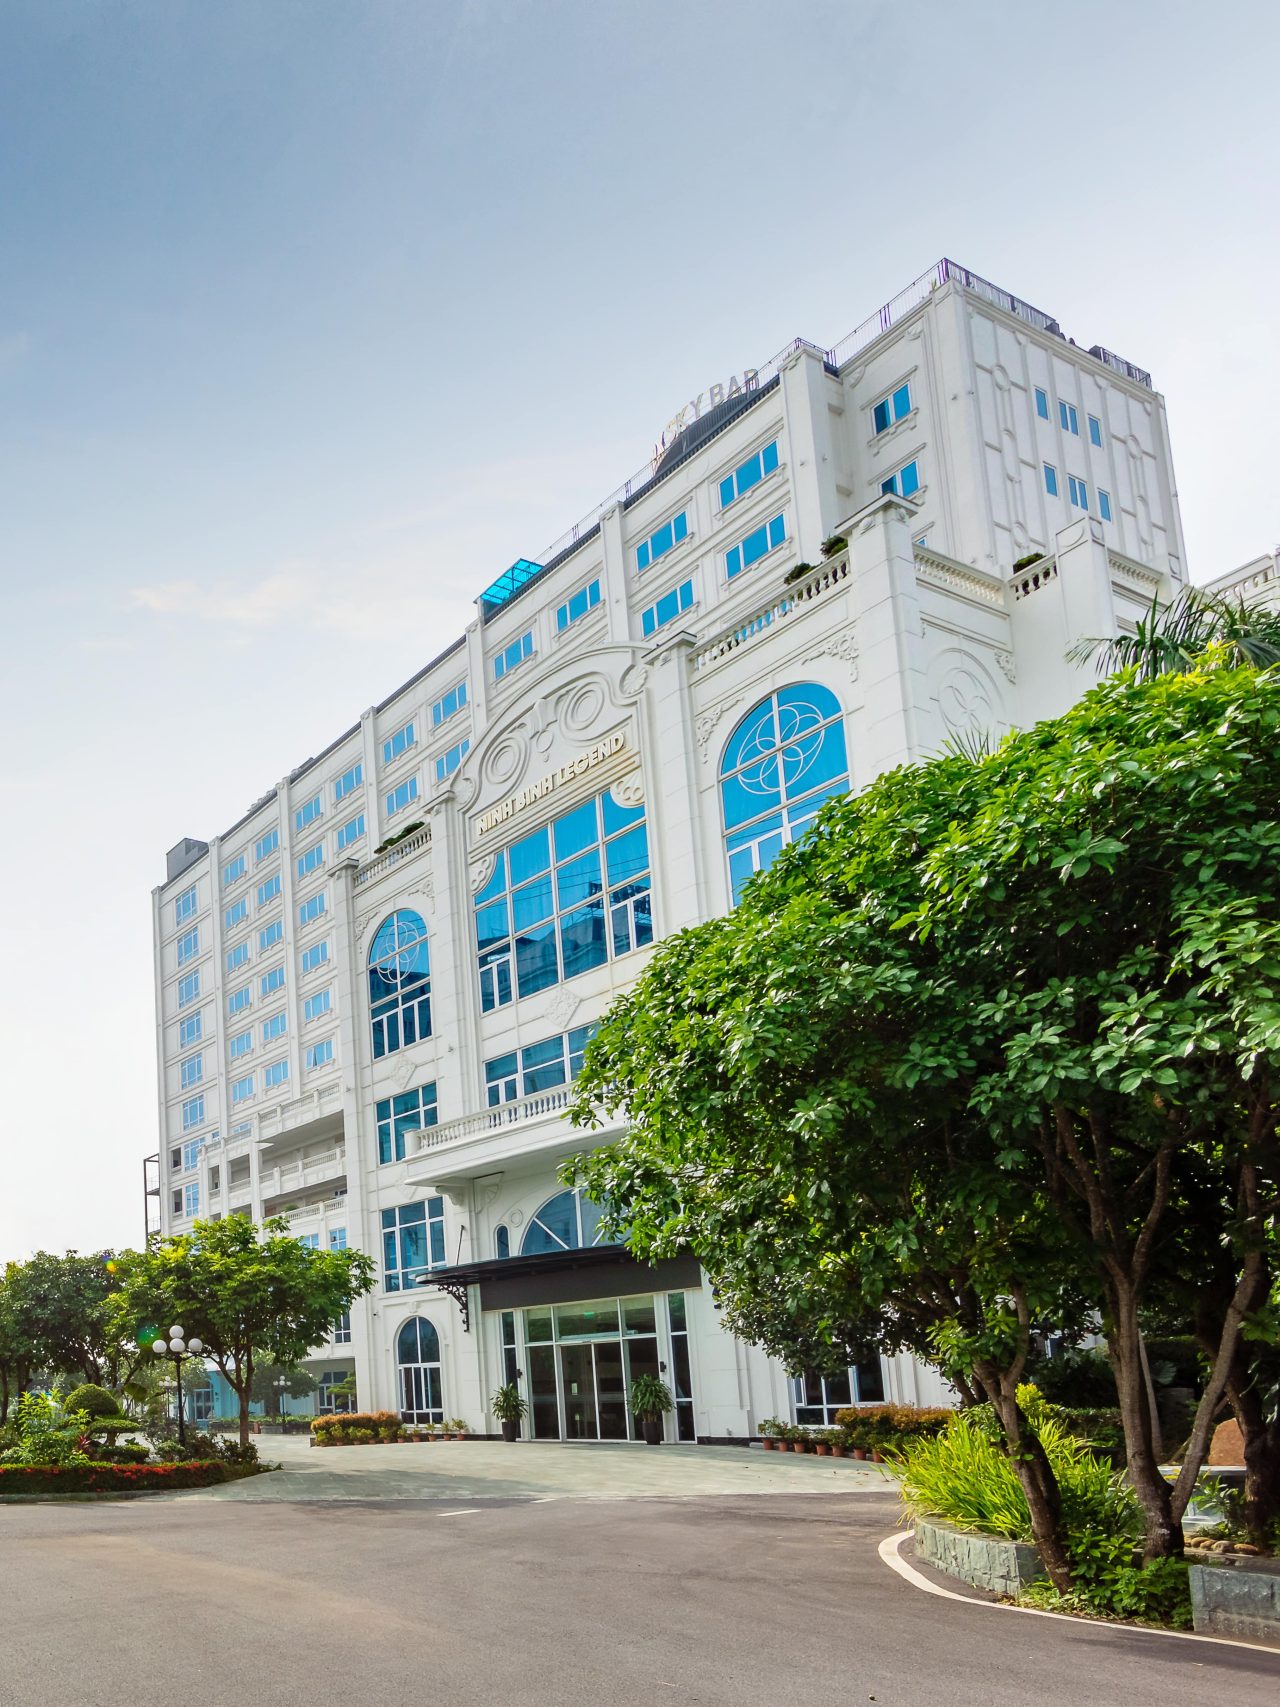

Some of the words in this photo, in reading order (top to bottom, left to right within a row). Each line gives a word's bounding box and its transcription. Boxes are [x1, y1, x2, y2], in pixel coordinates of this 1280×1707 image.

[709, 368, 760, 409] BAR
[477, 799, 514, 836] NINH
[516, 774, 555, 812] BINH
[557, 732, 625, 788] LEGEND
